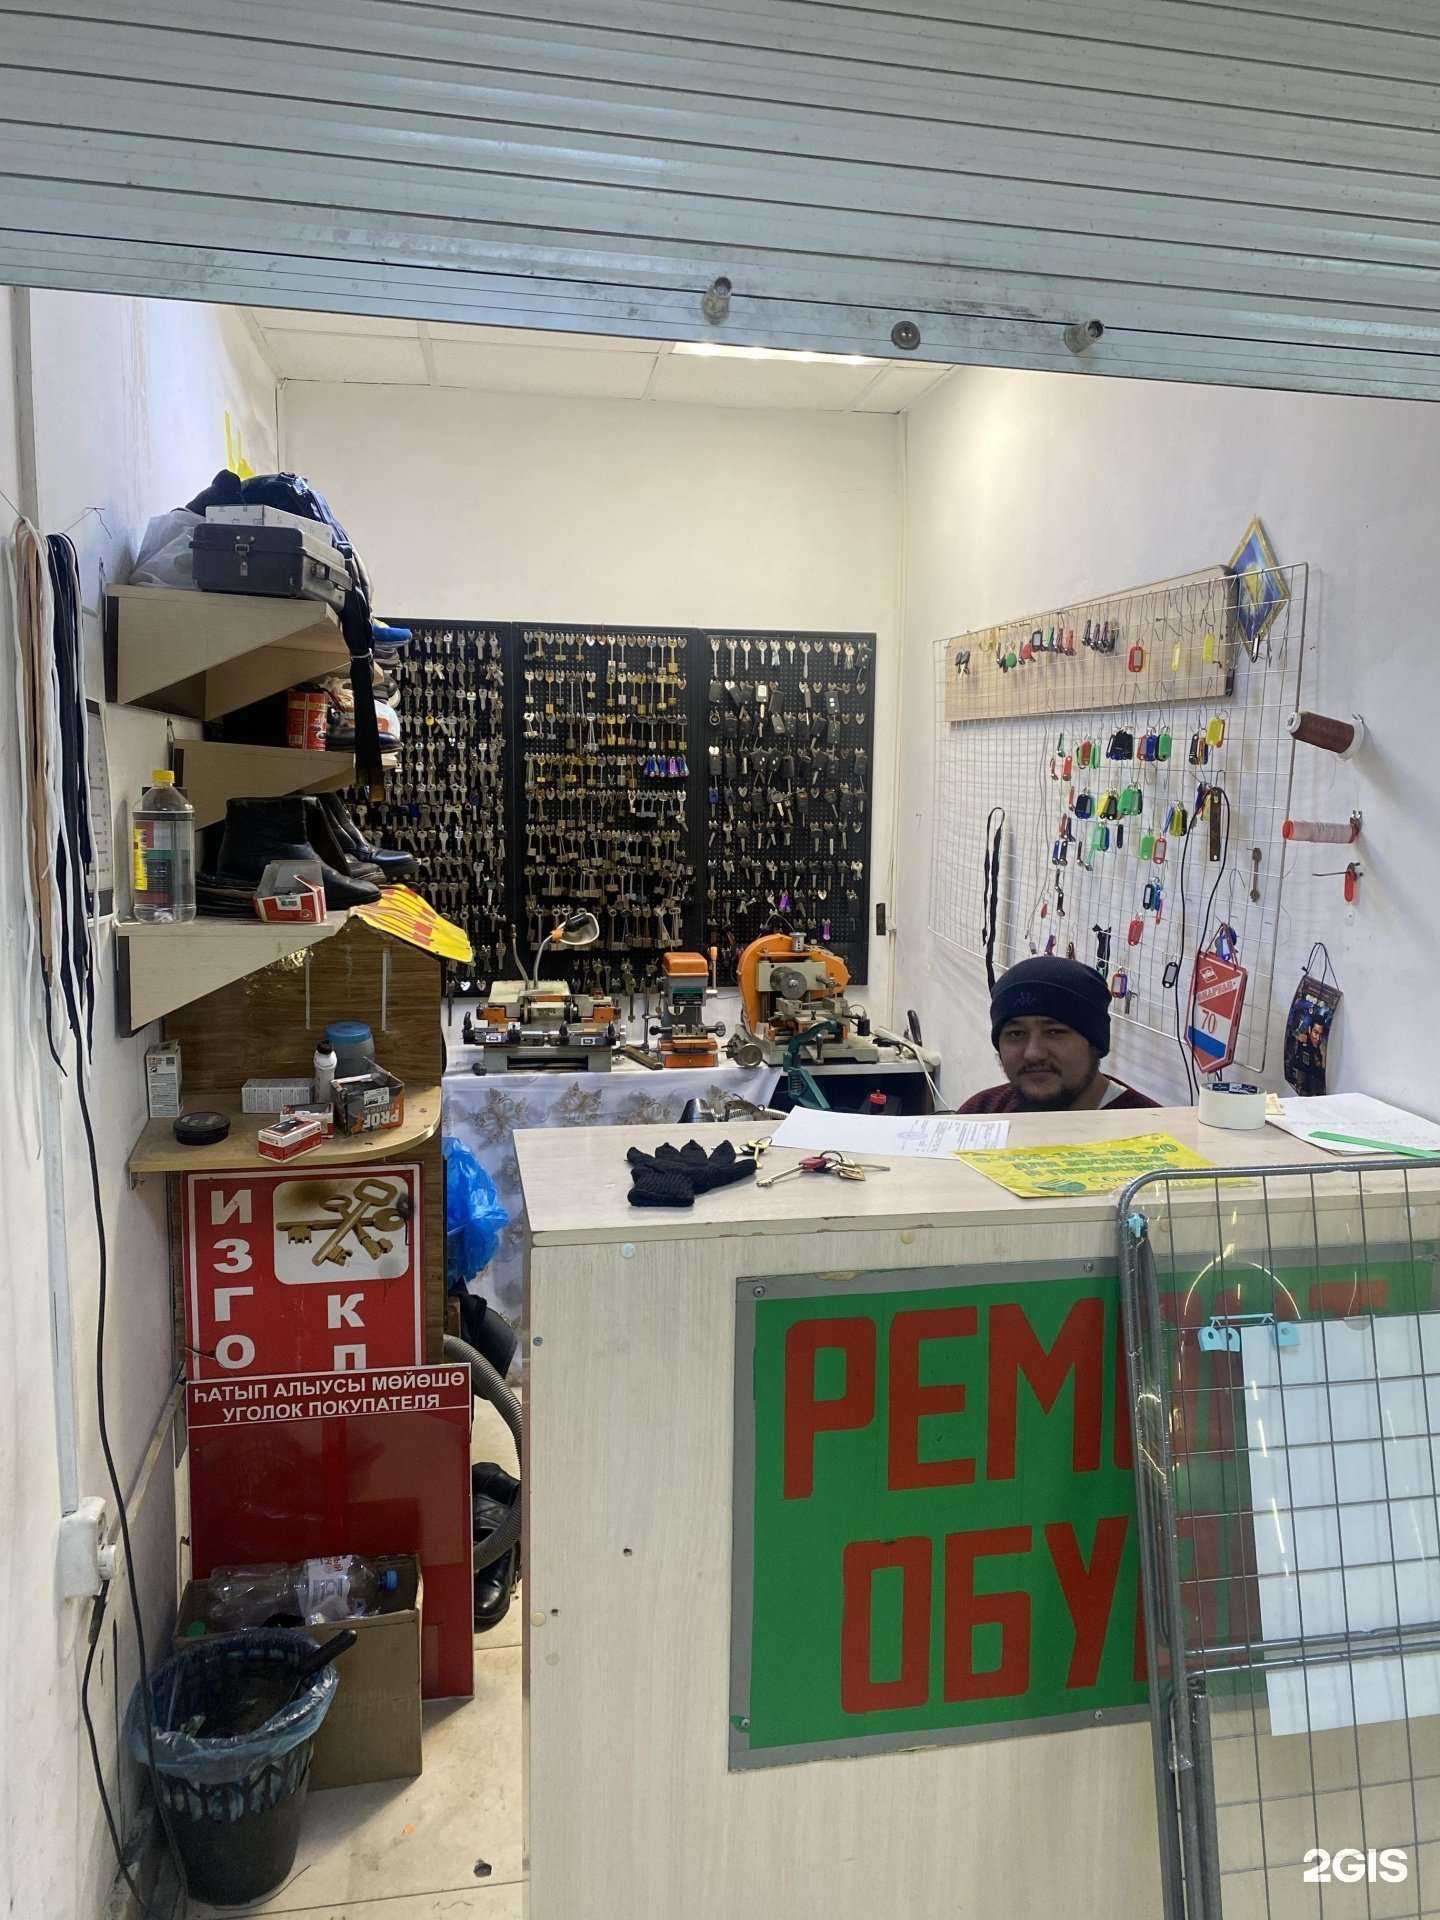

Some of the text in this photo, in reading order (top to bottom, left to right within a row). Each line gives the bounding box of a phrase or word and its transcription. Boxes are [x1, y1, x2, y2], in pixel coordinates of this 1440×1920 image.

[1202, 1009, 1217, 1034] 70
[273, 1377, 366, 1398] АЛЫУСЫ
[372, 1371, 465, 1391] МӨЙӨШӨ
[222, 1394, 440, 1422] УГОЛОК ПОКУПАТЕЛЯ
